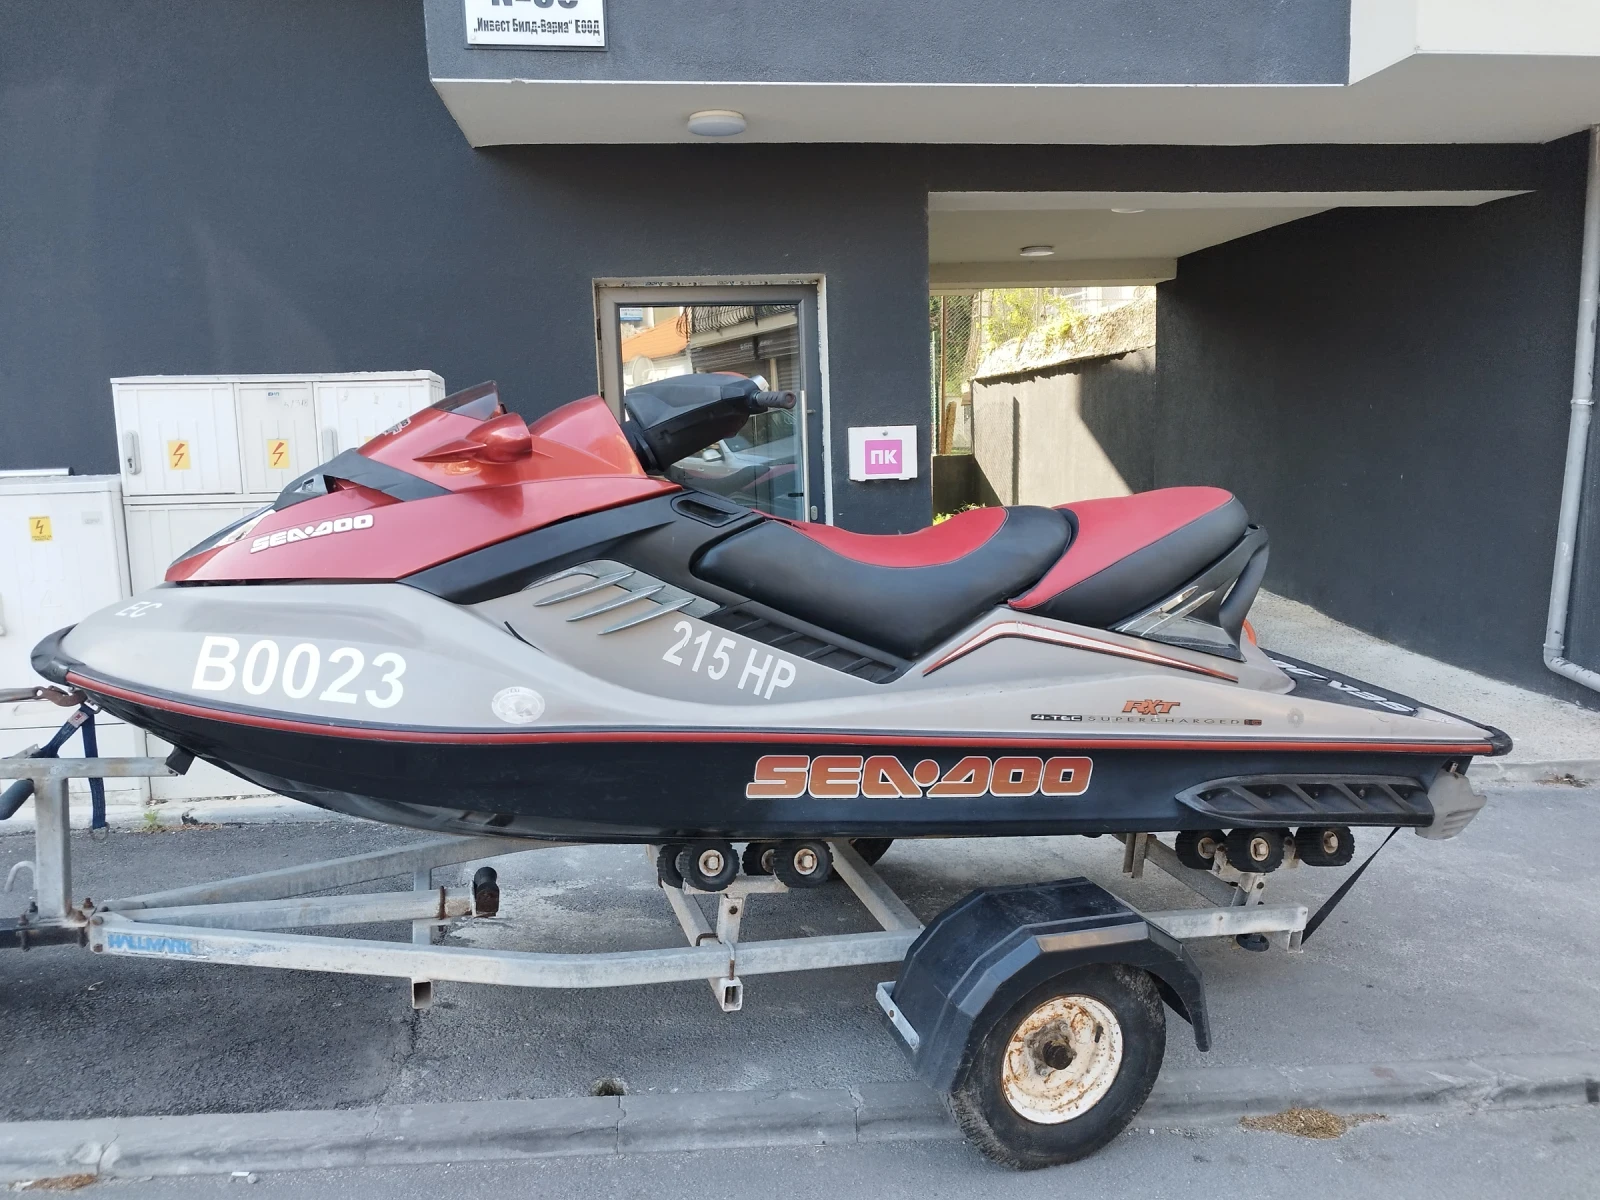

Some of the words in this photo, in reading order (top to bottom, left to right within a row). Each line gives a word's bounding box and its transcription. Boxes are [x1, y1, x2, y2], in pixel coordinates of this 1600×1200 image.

[575, 19, 600, 36] ЕООД
[871, 449, 898, 465] ПК
[662, 621, 736, 681] 215
[737, 647, 796, 700] HP
[192, 635, 407, 709] B0023
[1122, 699, 1181, 715] RXT
[1088, 716, 1240, 725] SUPERCHARGED
